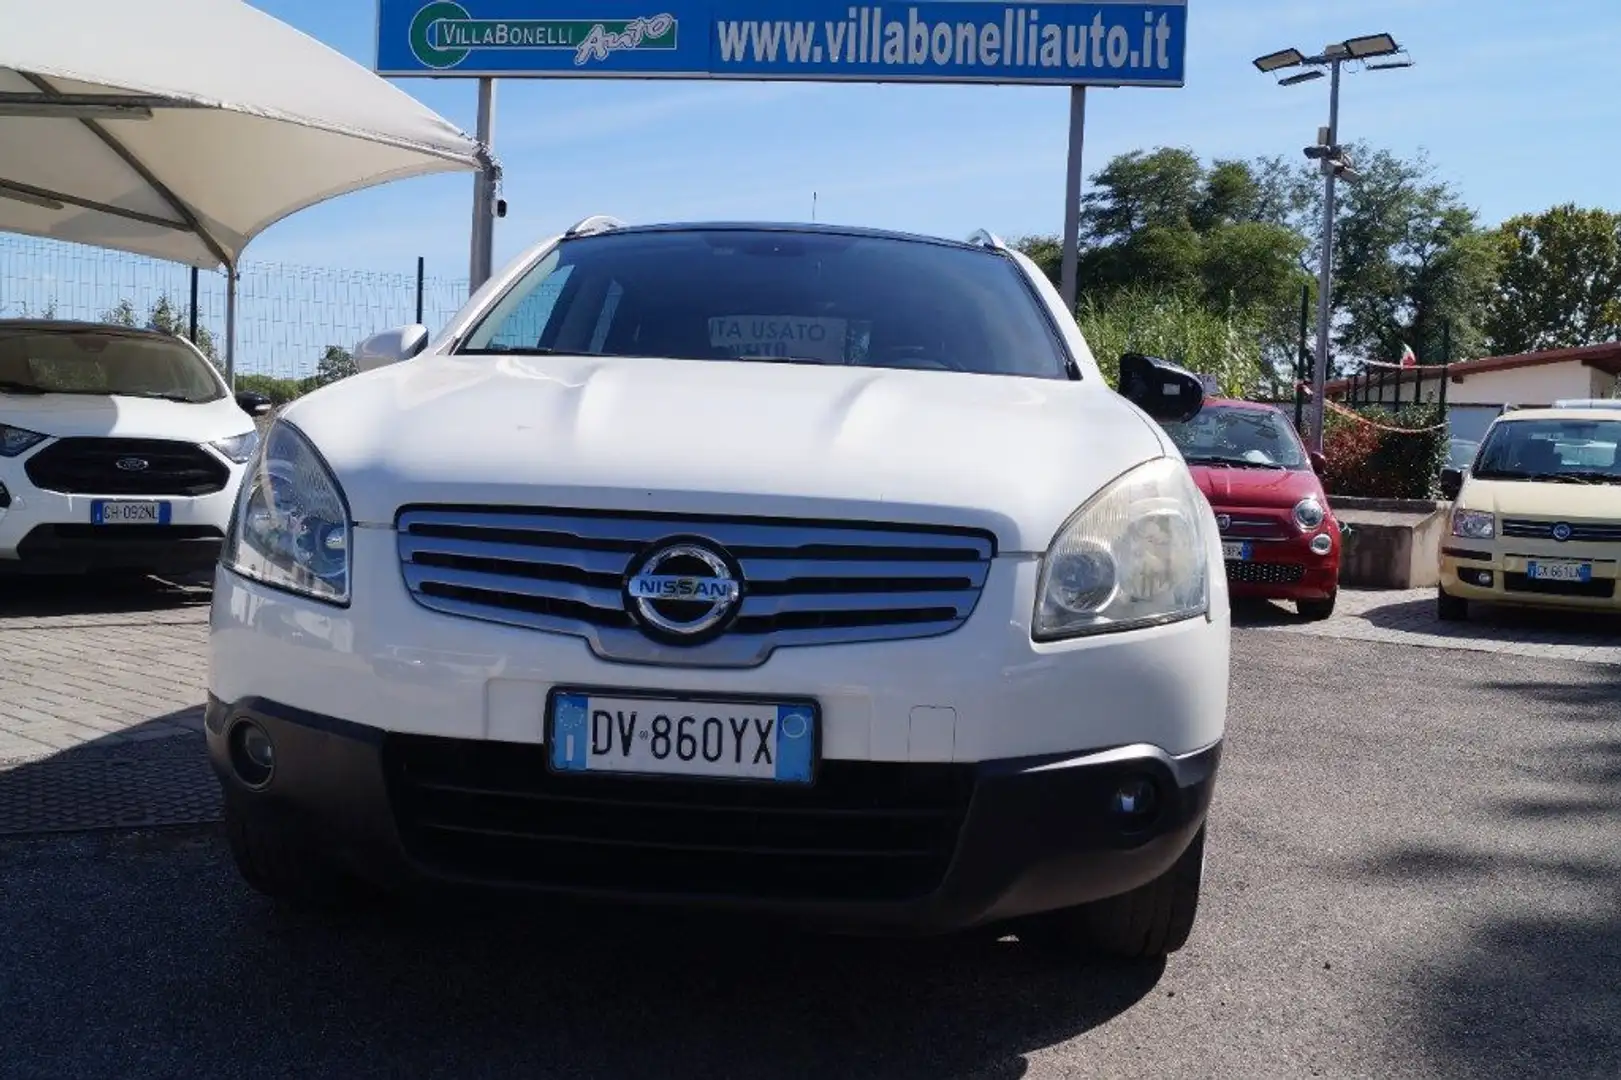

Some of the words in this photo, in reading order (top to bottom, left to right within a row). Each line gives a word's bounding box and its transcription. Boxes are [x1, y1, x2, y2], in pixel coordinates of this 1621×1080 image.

[717, 7, 1171, 70] www.villabonelliauto.it
[752, 321, 826, 342] USATO
[639, 579, 727, 597] NISSAN
[592, 710, 637, 757] DV
[651, 715, 774, 765] 860YX
